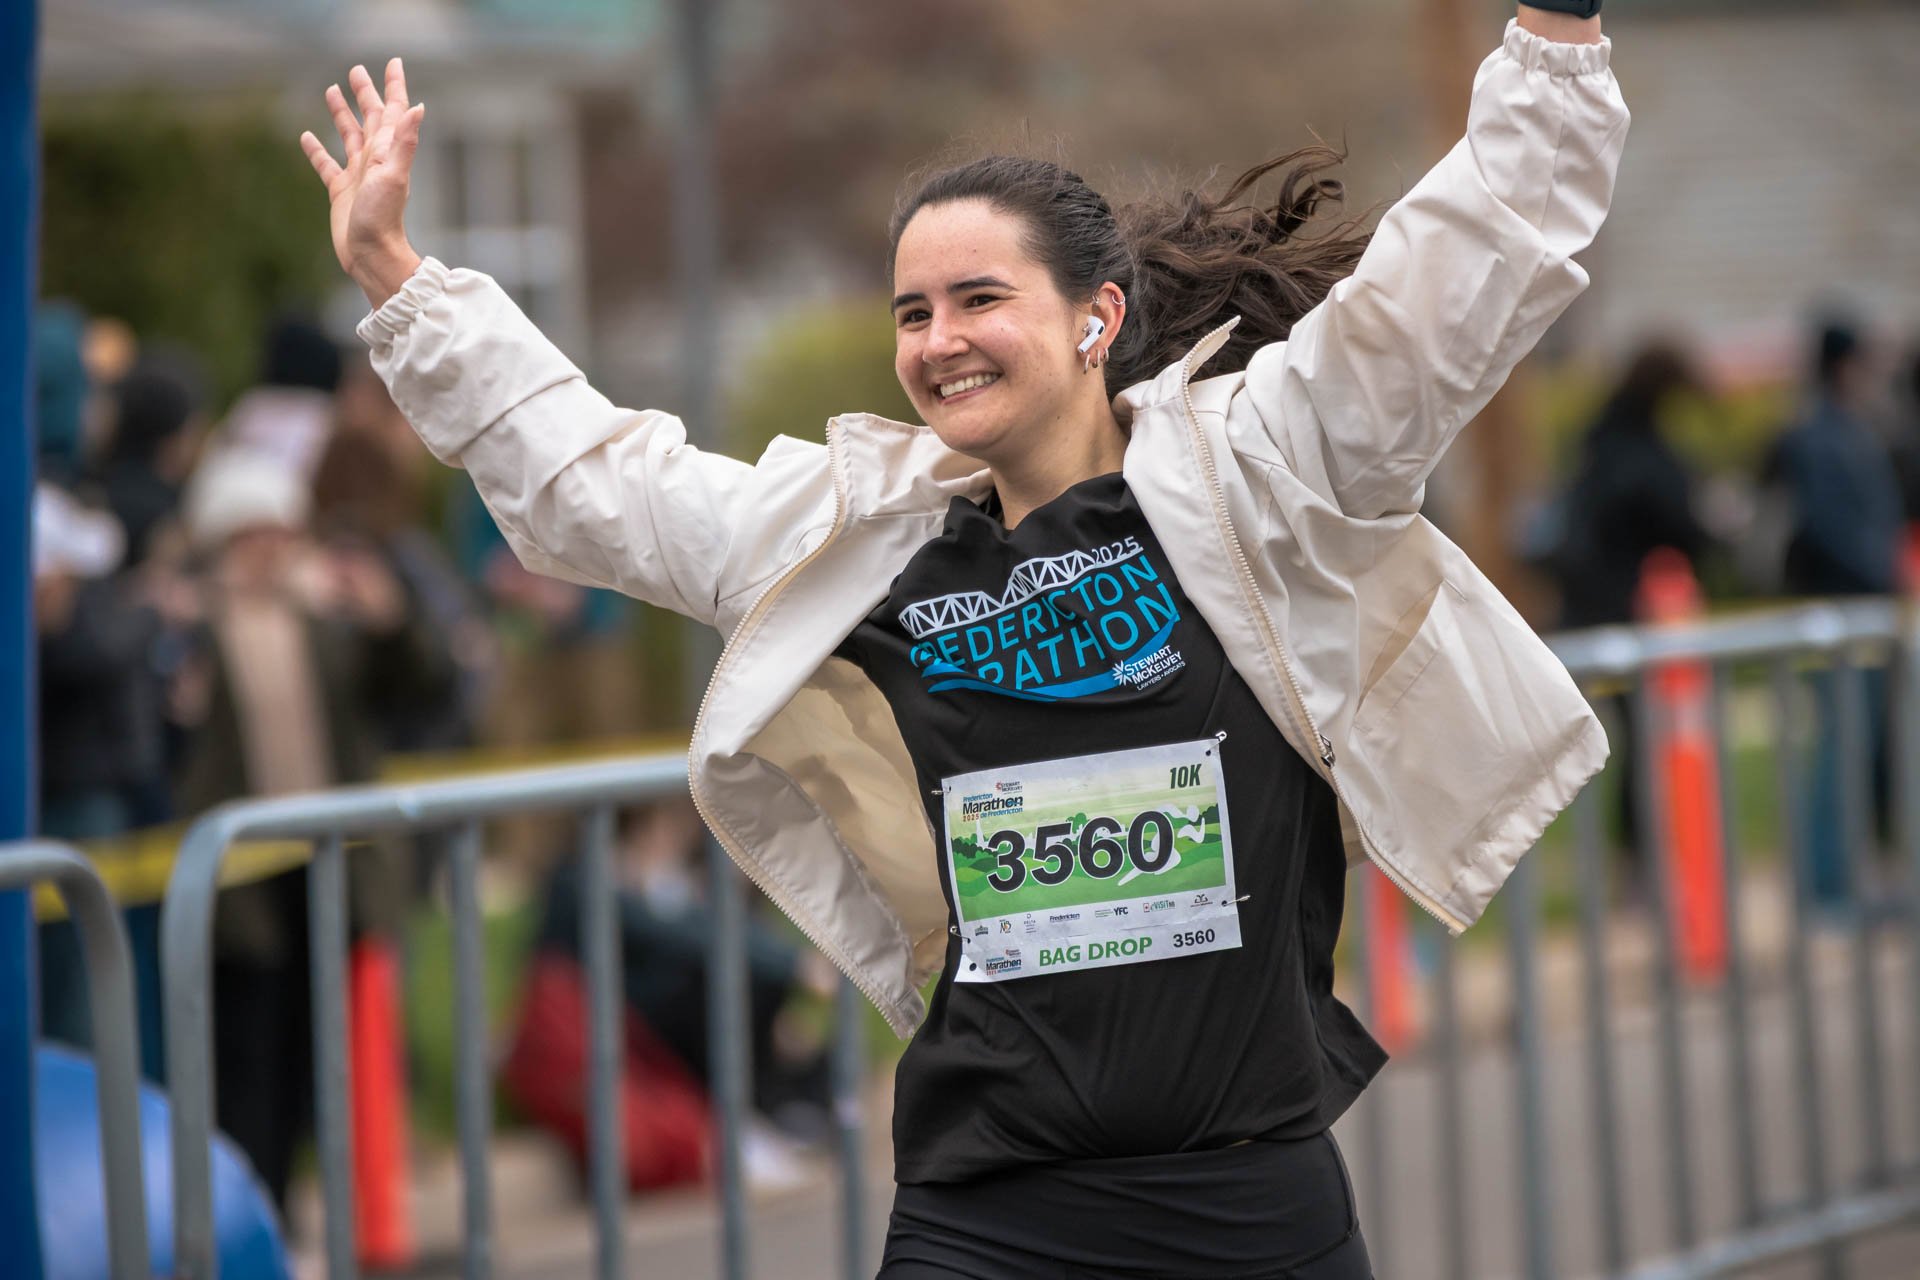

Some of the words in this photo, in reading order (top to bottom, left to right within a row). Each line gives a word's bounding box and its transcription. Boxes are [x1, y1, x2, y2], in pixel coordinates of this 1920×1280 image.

[1091, 536, 1141, 564] 2025
[911, 555, 1158, 667] EDERICTON
[1124, 645, 1172, 676] STEWART
[1137, 675, 1162, 691] LAWYERS
[1163, 661, 1186, 677] AVOCATS
[1169, 763, 1202, 790] 10K
[963, 793, 993, 802] Fredericton
[963, 796, 1024, 815] Marathon
[963, 813, 979, 822] 2025
[988, 807, 1024, 817] Fredericton
[986, 810, 1175, 894] 3560
[1049, 913, 1080, 922] Fredericton
[1113, 907, 1129, 916] YFC
[1173, 928, 1215, 948] 3560
[1040, 945, 1080, 967] BAG
[1088, 936, 1153, 961] DROP
[986, 959, 1022, 971] Marathon
